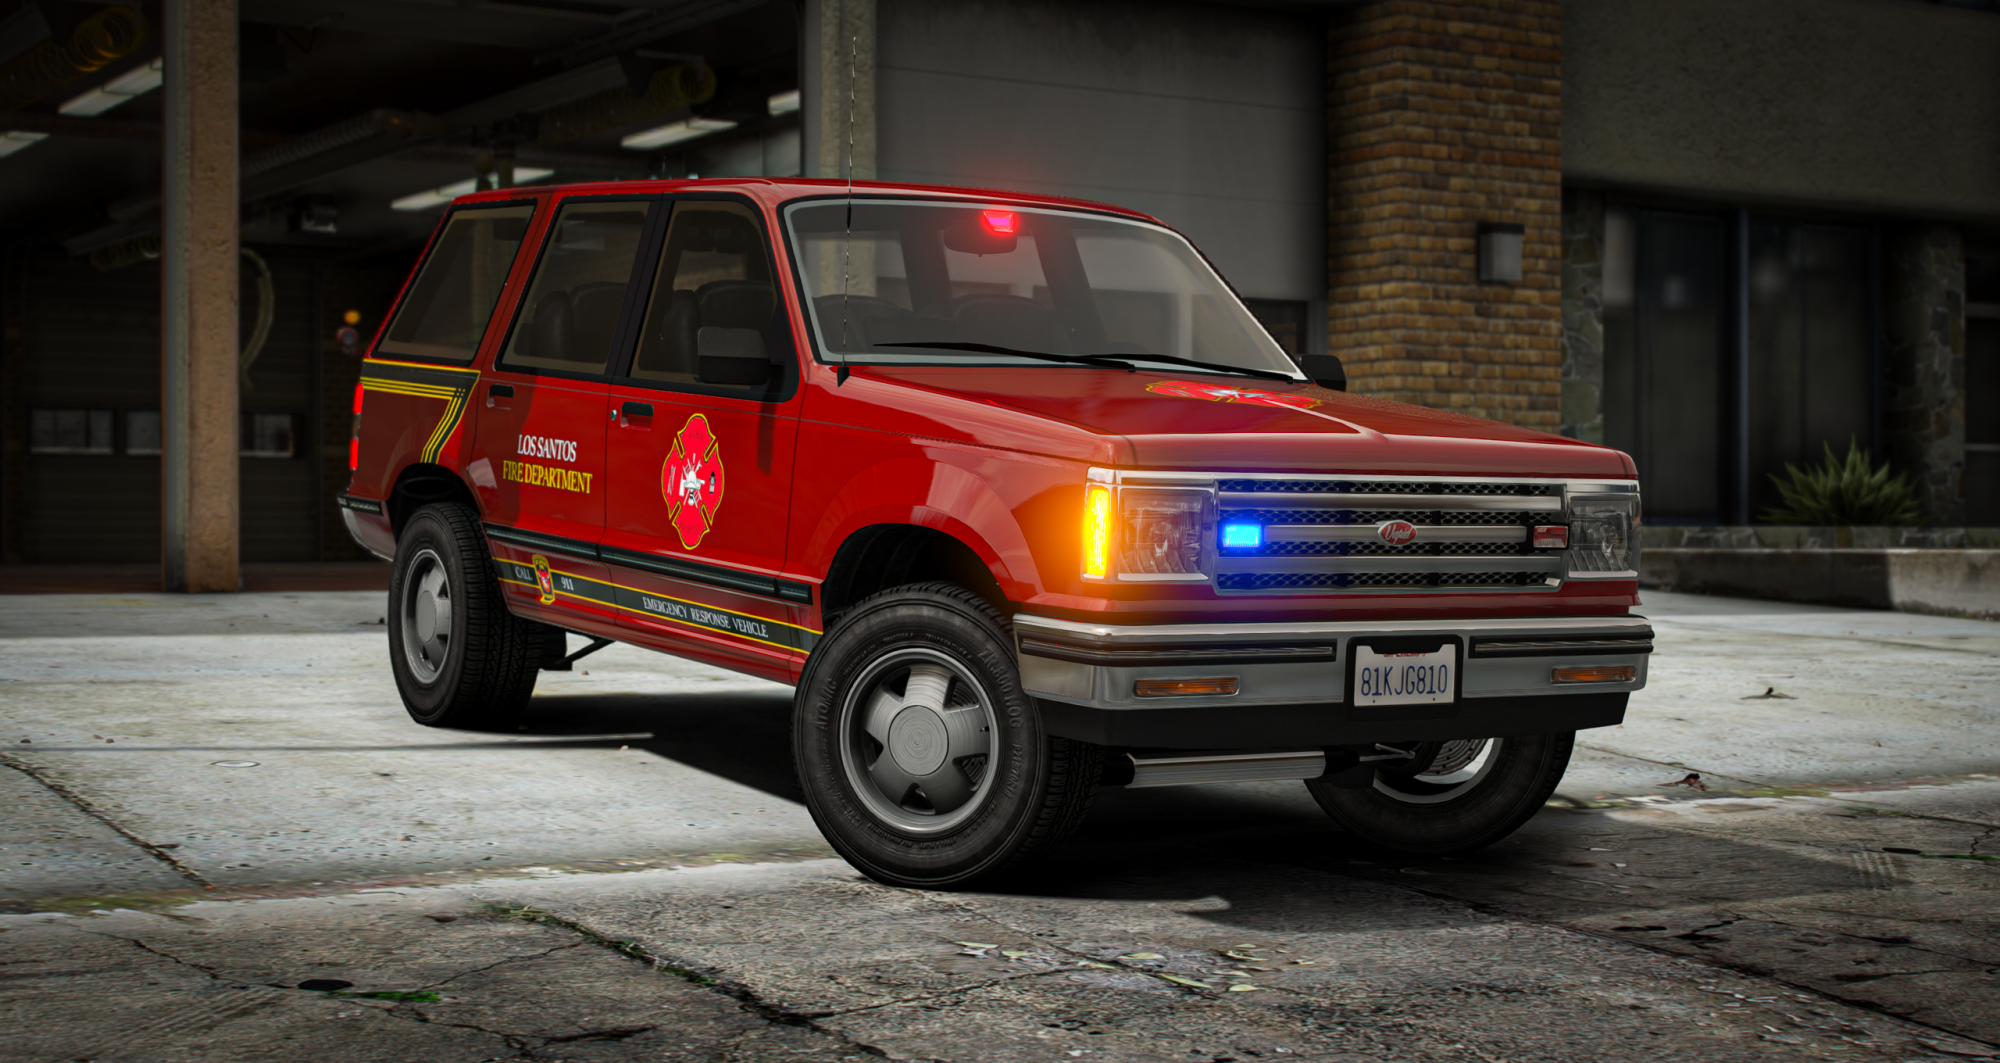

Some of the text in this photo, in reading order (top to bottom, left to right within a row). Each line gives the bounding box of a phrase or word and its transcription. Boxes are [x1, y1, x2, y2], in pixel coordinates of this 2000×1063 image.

[517, 434, 577, 463] LOS SANTOS
[503, 460, 593, 494] FIRE DEPARTMENT
[1385, 523, 1413, 545] Vapid
[515, 566, 533, 581] CALL
[561, 576, 574, 591] 911
[642, 596, 769, 638] EMERGENCY RESPONSE VEHICLE
[1361, 663, 1448, 697] 81KJG810
[815, 678, 837, 733] ATOMIC
